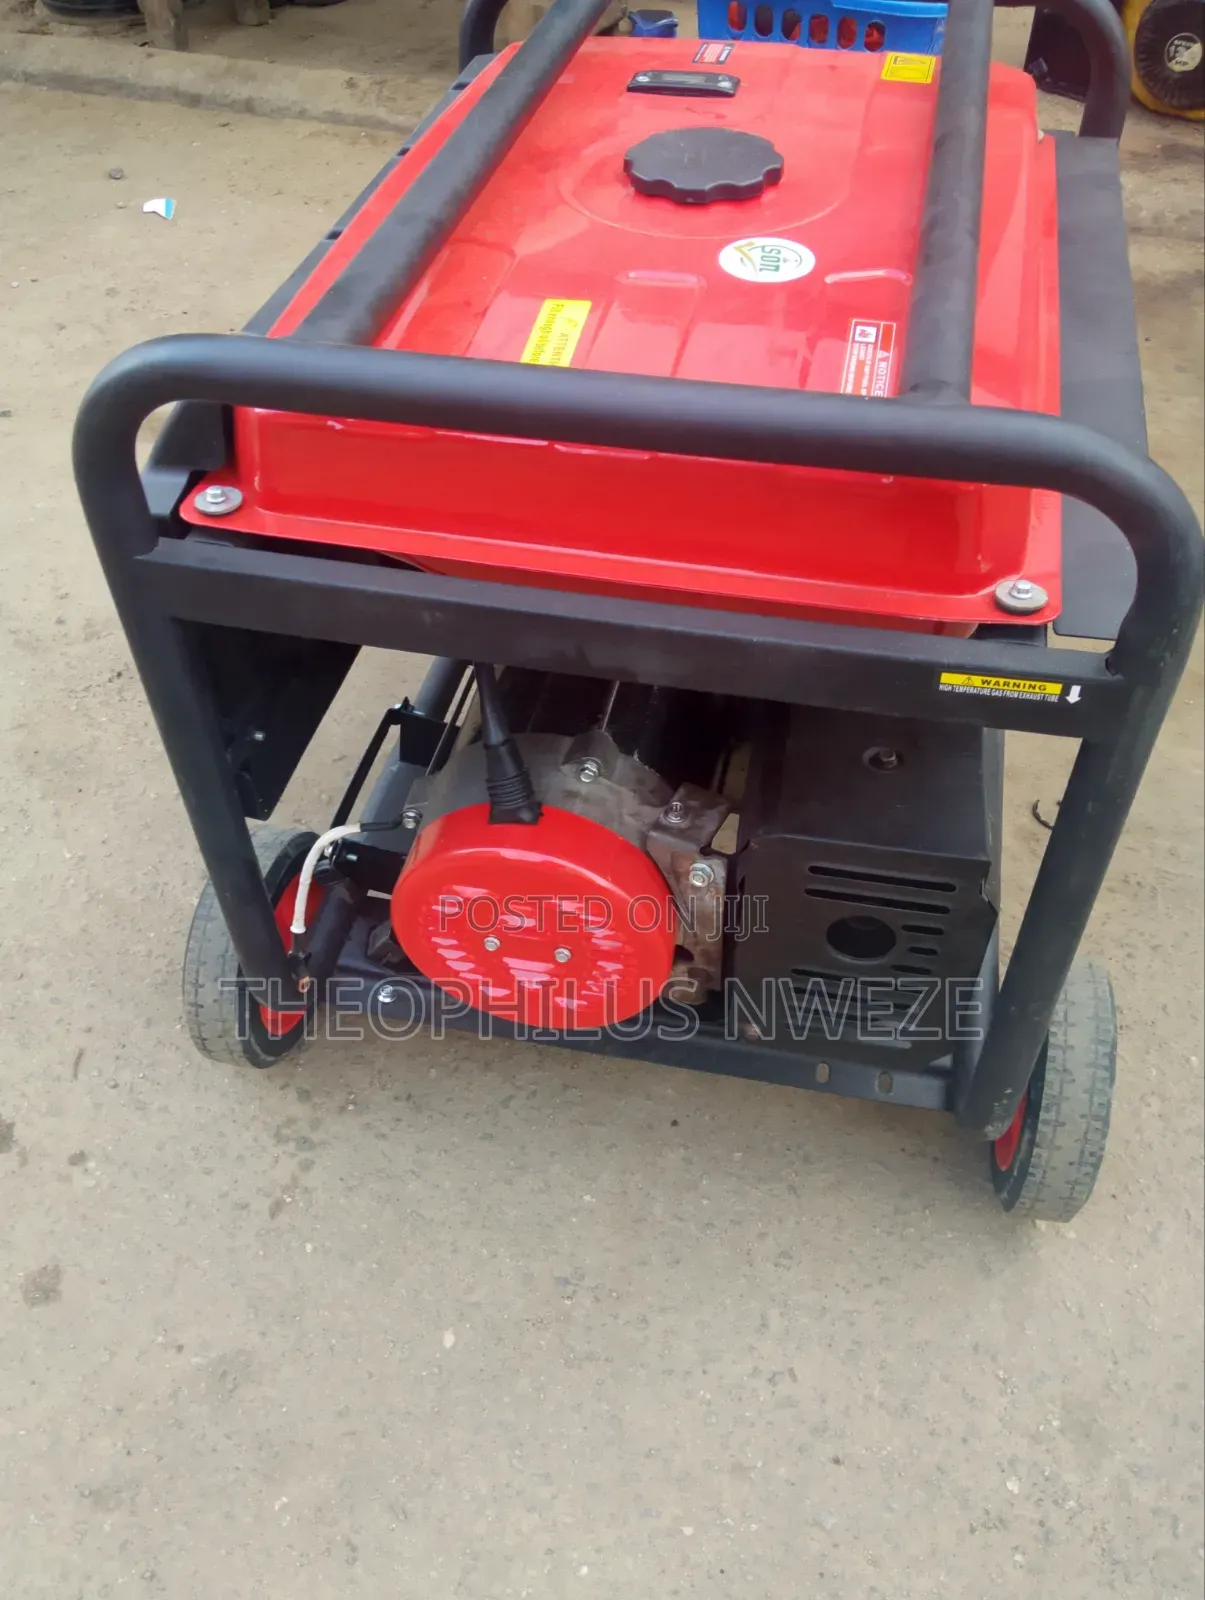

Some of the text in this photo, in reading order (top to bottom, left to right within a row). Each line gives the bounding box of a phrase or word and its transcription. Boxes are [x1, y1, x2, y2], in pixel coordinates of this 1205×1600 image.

[874, 361, 888, 397] NOTICE
[938, 683, 1060, 703] HIGH TEMPERATURE GAS FROM EXHAUST TUBE
[981, 678, 1048, 692] WARNING
